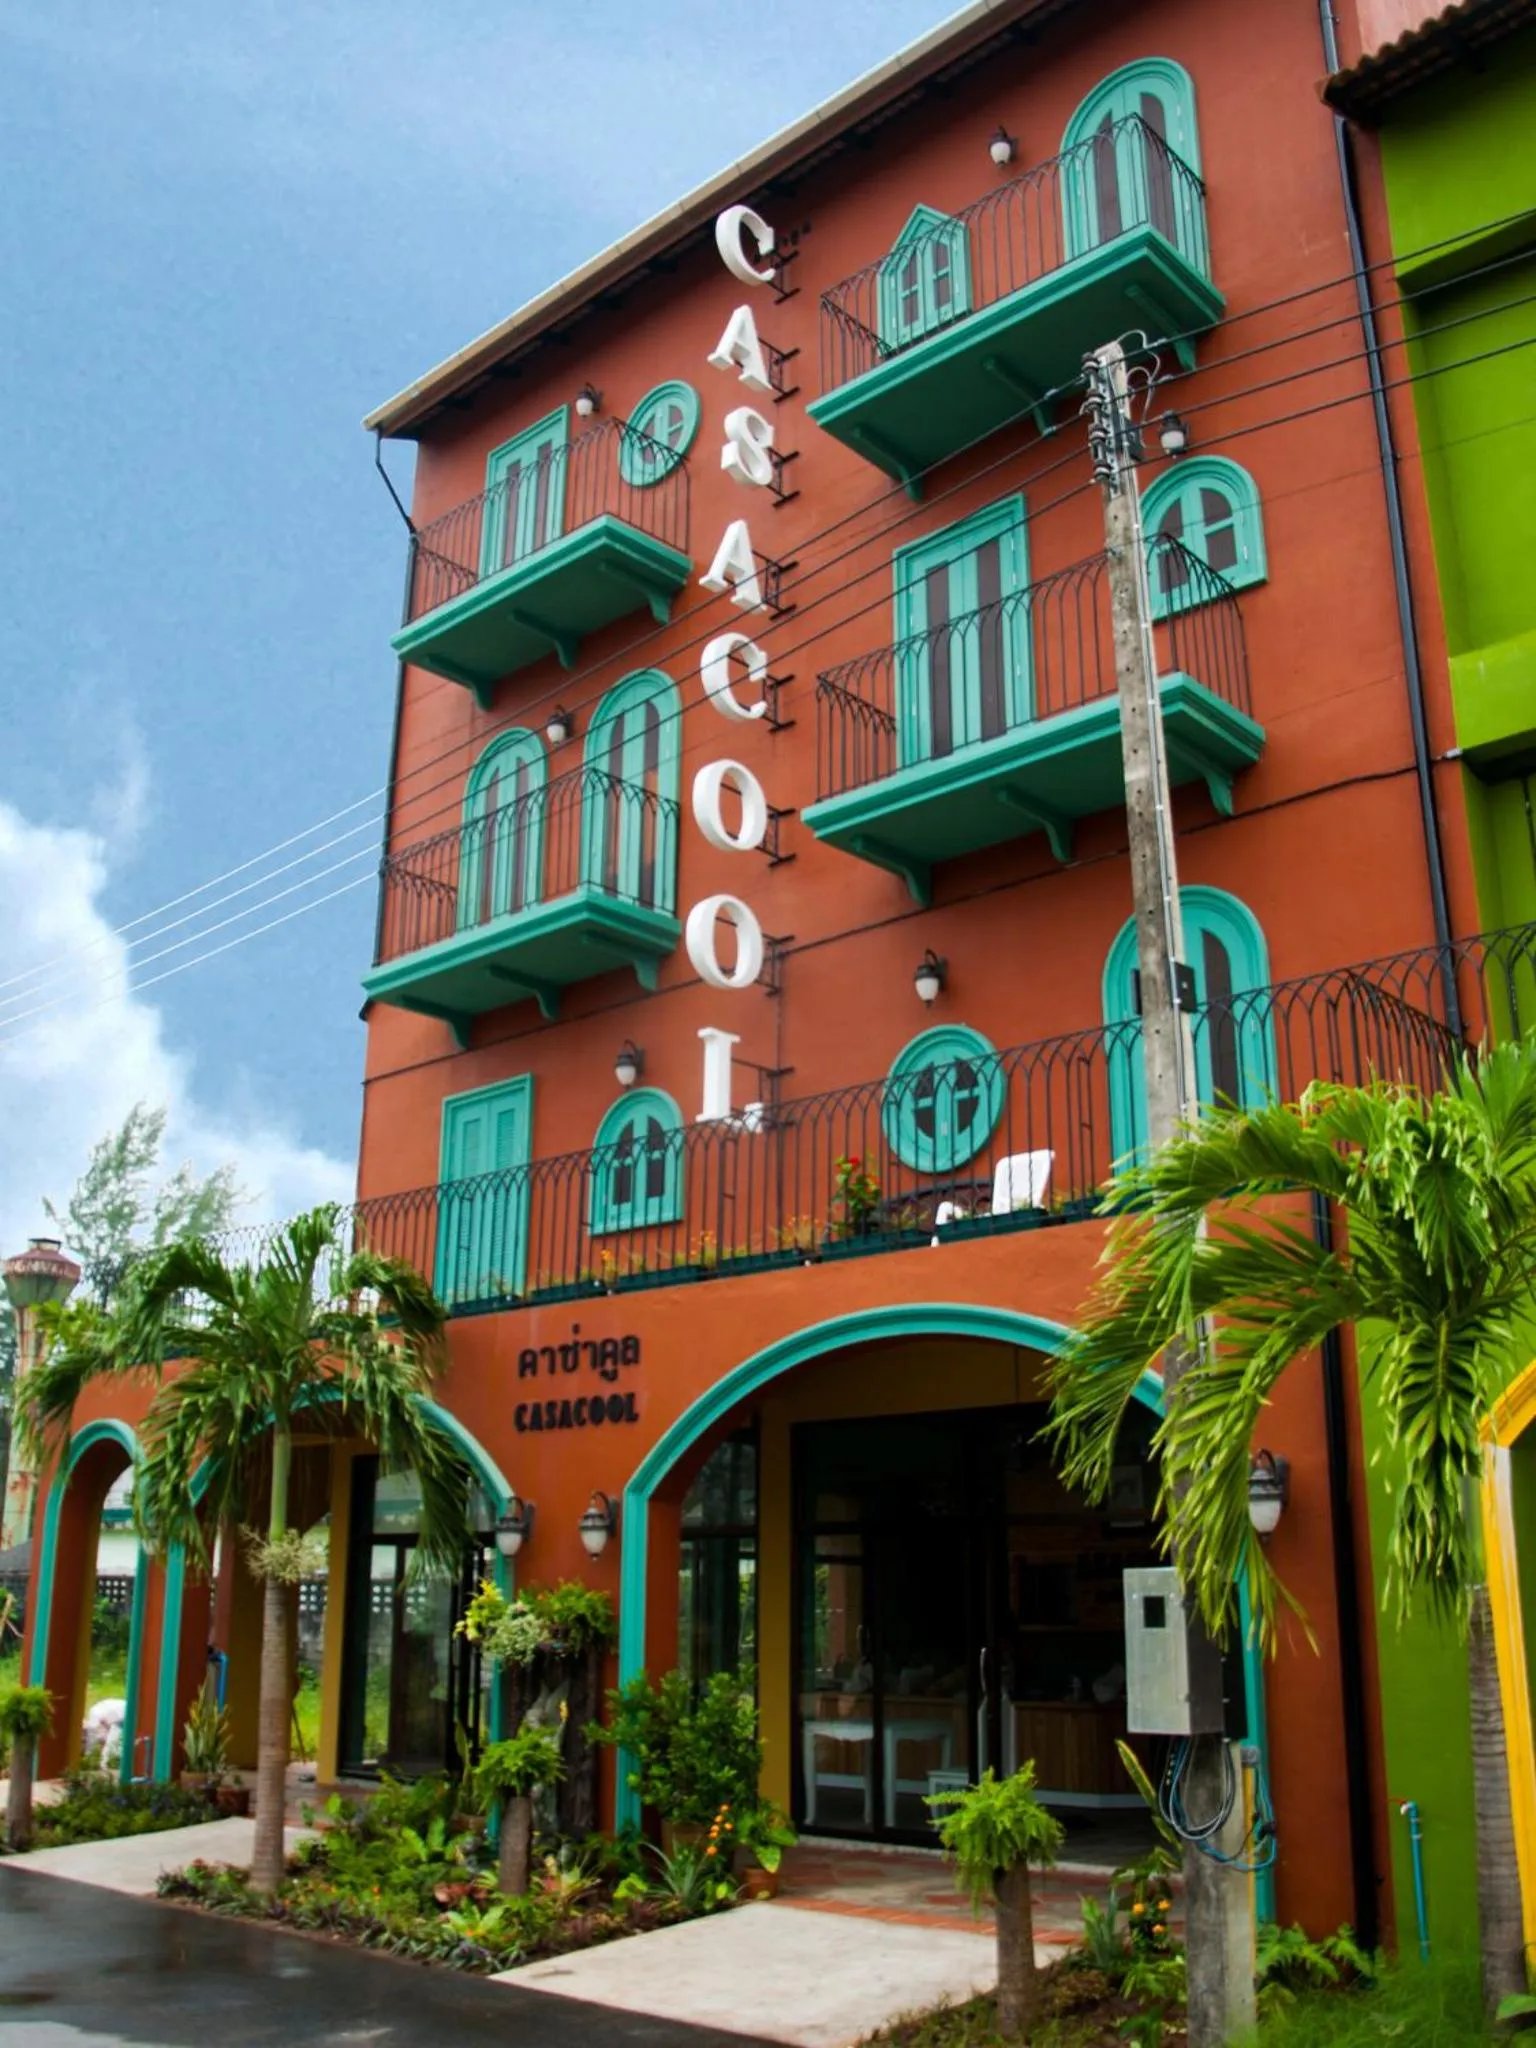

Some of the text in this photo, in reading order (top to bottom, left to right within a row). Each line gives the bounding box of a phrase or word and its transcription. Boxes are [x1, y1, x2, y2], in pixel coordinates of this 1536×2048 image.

[686, 204, 776, 1132] CASACOOL
[518, 1323, 641, 1382] คาซ่าคูล
[515, 1392, 639, 1433] CASACOOL
